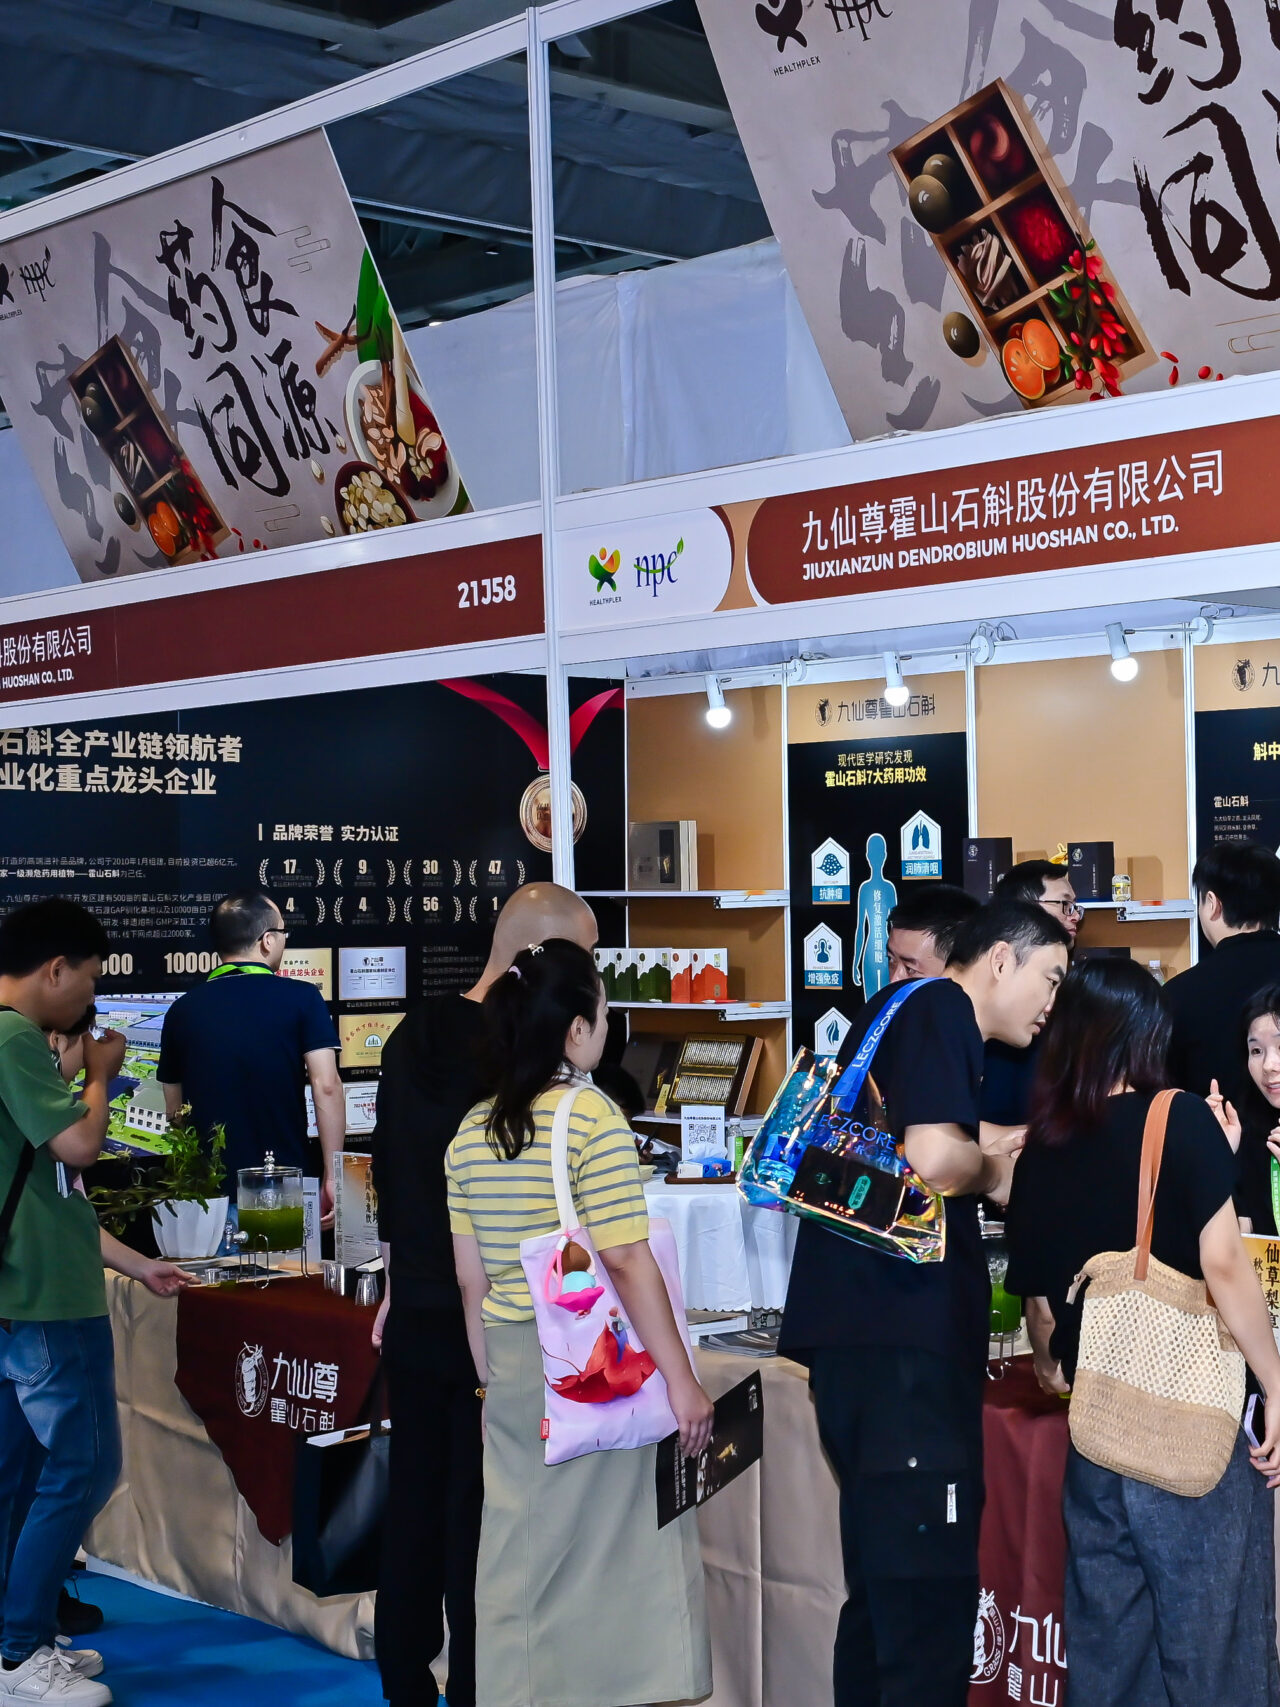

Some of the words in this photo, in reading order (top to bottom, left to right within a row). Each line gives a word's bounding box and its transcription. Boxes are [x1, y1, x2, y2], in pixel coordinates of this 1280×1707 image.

[773, 55, 821, 77] HEALTHPLEX
[801, 449, 1224, 554] 九仙尊霍山石斛股份有限公司
[802, 548, 894, 582] JIUXIANZUN
[897, 535, 1009, 570] DENDROBIUM
[1010, 525, 1100, 555] HUOSHAN
[1102, 521, 1137, 544] CO.,
[1141, 513, 1180, 536] LTD.
[634, 540, 683, 598] npc
[457, 574, 518, 609] 21J58
[589, 596, 622, 607] HEALTHPLEX
[0, 624, 92, 668] 股份有限公司
[2, 672, 40, 689] HUOSHAN
[41, 670, 57, 684] CO.,
[57, 668, 75, 682] LTD.
[0, 728, 243, 763] 石斛全产业链领航者
[837, 750, 913, 767] 现代医学研究发现
[0, 761, 217, 795] 业化重点龙头企业
[825, 766, 927, 788] 霍山石斛7大药用功效
[1213, 795, 1249, 808] 霍山石斛
[272, 824, 334, 842] 品牌荣誉
[341, 825, 399, 842] 实力认证
[283, 859, 298, 875] 17
[358, 859, 368, 875] 9
[422, 859, 440, 875] 30
[488, 860, 502, 875] 47
[286, 897, 294, 912] 4
[359, 897, 367, 912] 4
[422, 896, 439, 911] 56
[807, 972, 840, 986] 增强免疫
[270, 1351, 340, 1404] 九仙尊
[270, 1397, 336, 1433] 霍山石斛
